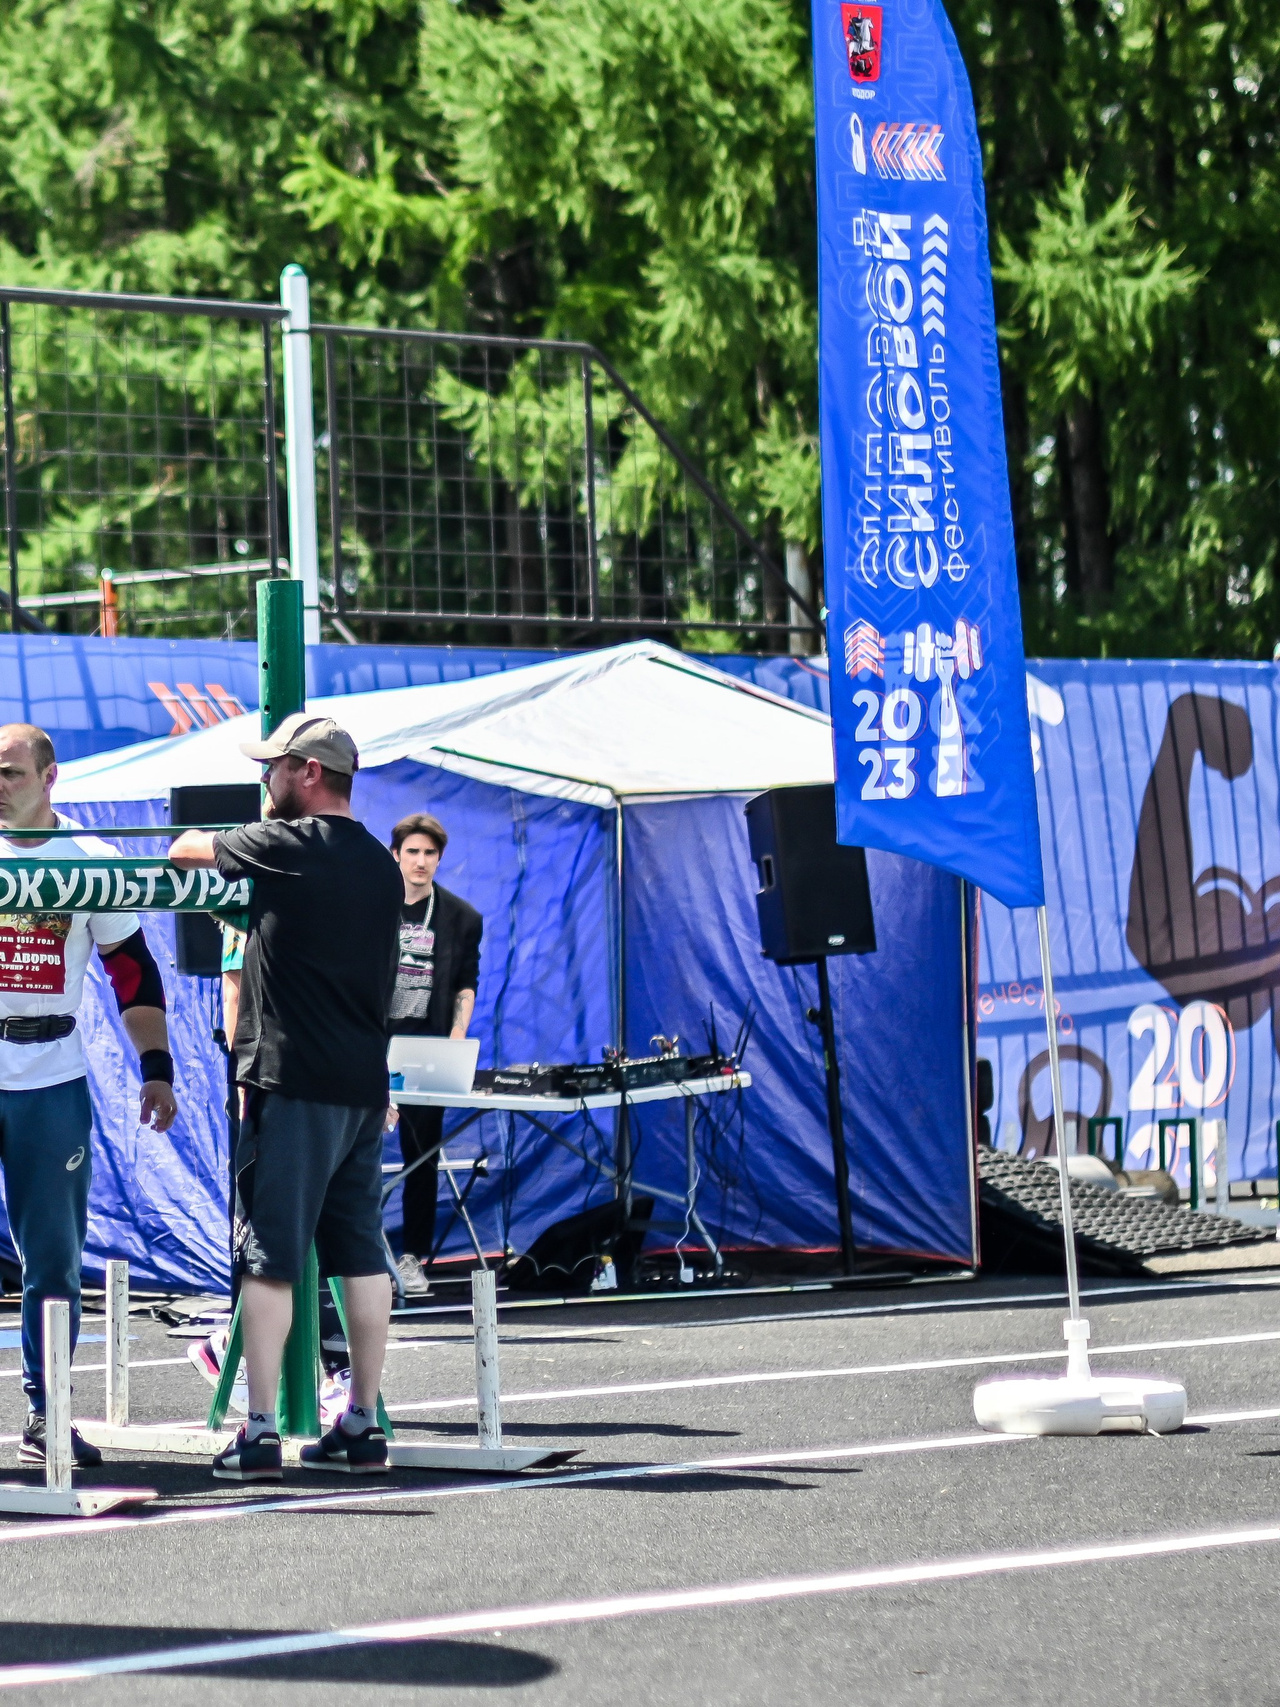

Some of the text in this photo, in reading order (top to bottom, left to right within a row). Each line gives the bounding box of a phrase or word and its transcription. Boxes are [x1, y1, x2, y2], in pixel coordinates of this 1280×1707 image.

[863, 212, 939, 590] СИЛОВОЙ
[927, 343, 971, 583] фестиваль
[852, 689, 922, 742] 20
[858, 747, 917, 801] 23
[12, 952, 61, 965] ДВОРОВ
[16, 935, 34, 944] 1812
[494, 1075, 522, 1085] Pioneer
[1127, 1001, 1235, 1111] 20
